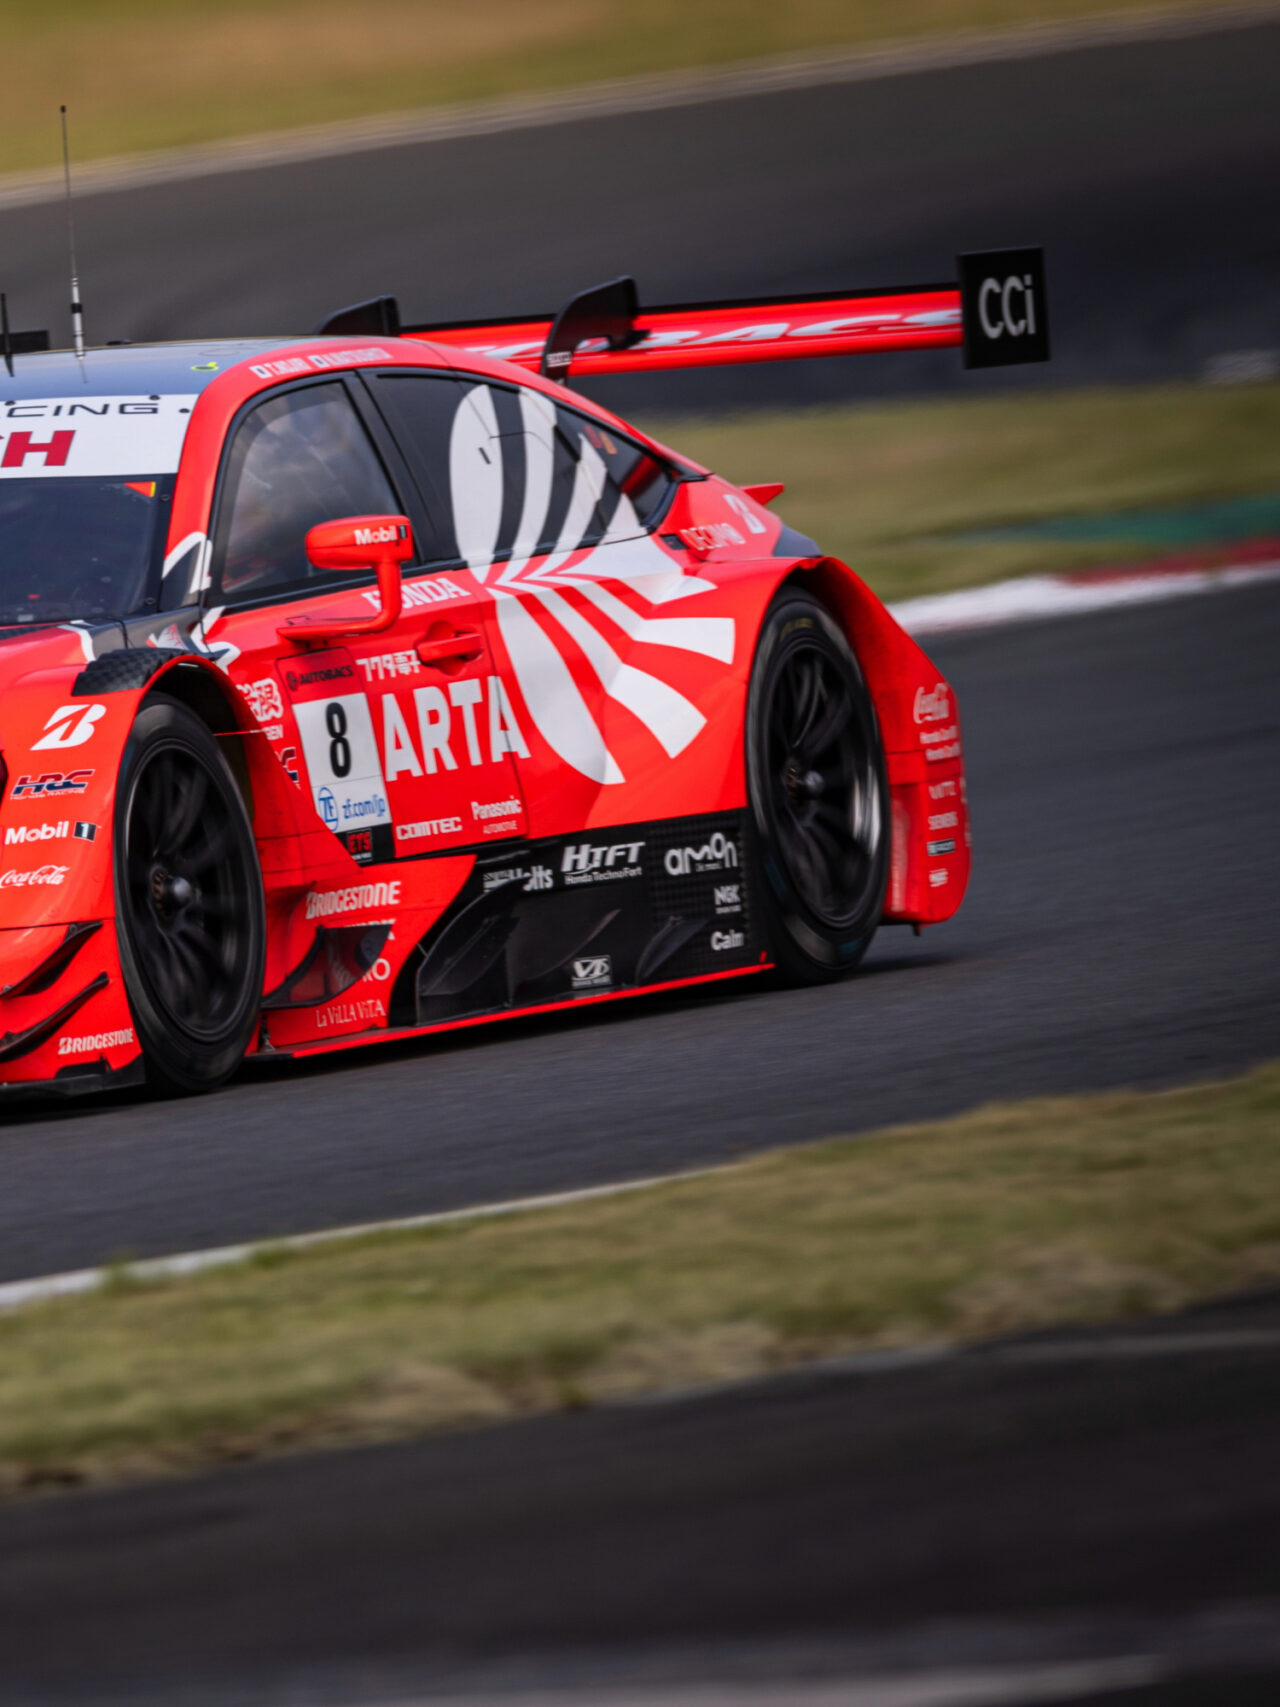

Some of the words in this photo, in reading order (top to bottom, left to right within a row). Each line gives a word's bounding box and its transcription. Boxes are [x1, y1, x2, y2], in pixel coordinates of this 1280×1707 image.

[354, 525, 397, 545] Mobil
[300, 666, 354, 685] AUTOBACS
[325, 702, 352, 779] 8
[381, 676, 531, 782] ARTA
[11, 768, 96, 796] HRC
[471, 795, 523, 820] Panasonic
[4, 821, 70, 845] Mobil
[396, 817, 462, 841] COMTEC
[561, 841, 646, 873] HTFT
[305, 881, 401, 919] BRIDGESTONE
[714, 884, 741, 905] NGK
[58, 1028, 134, 1055] BRIDGESTONE
